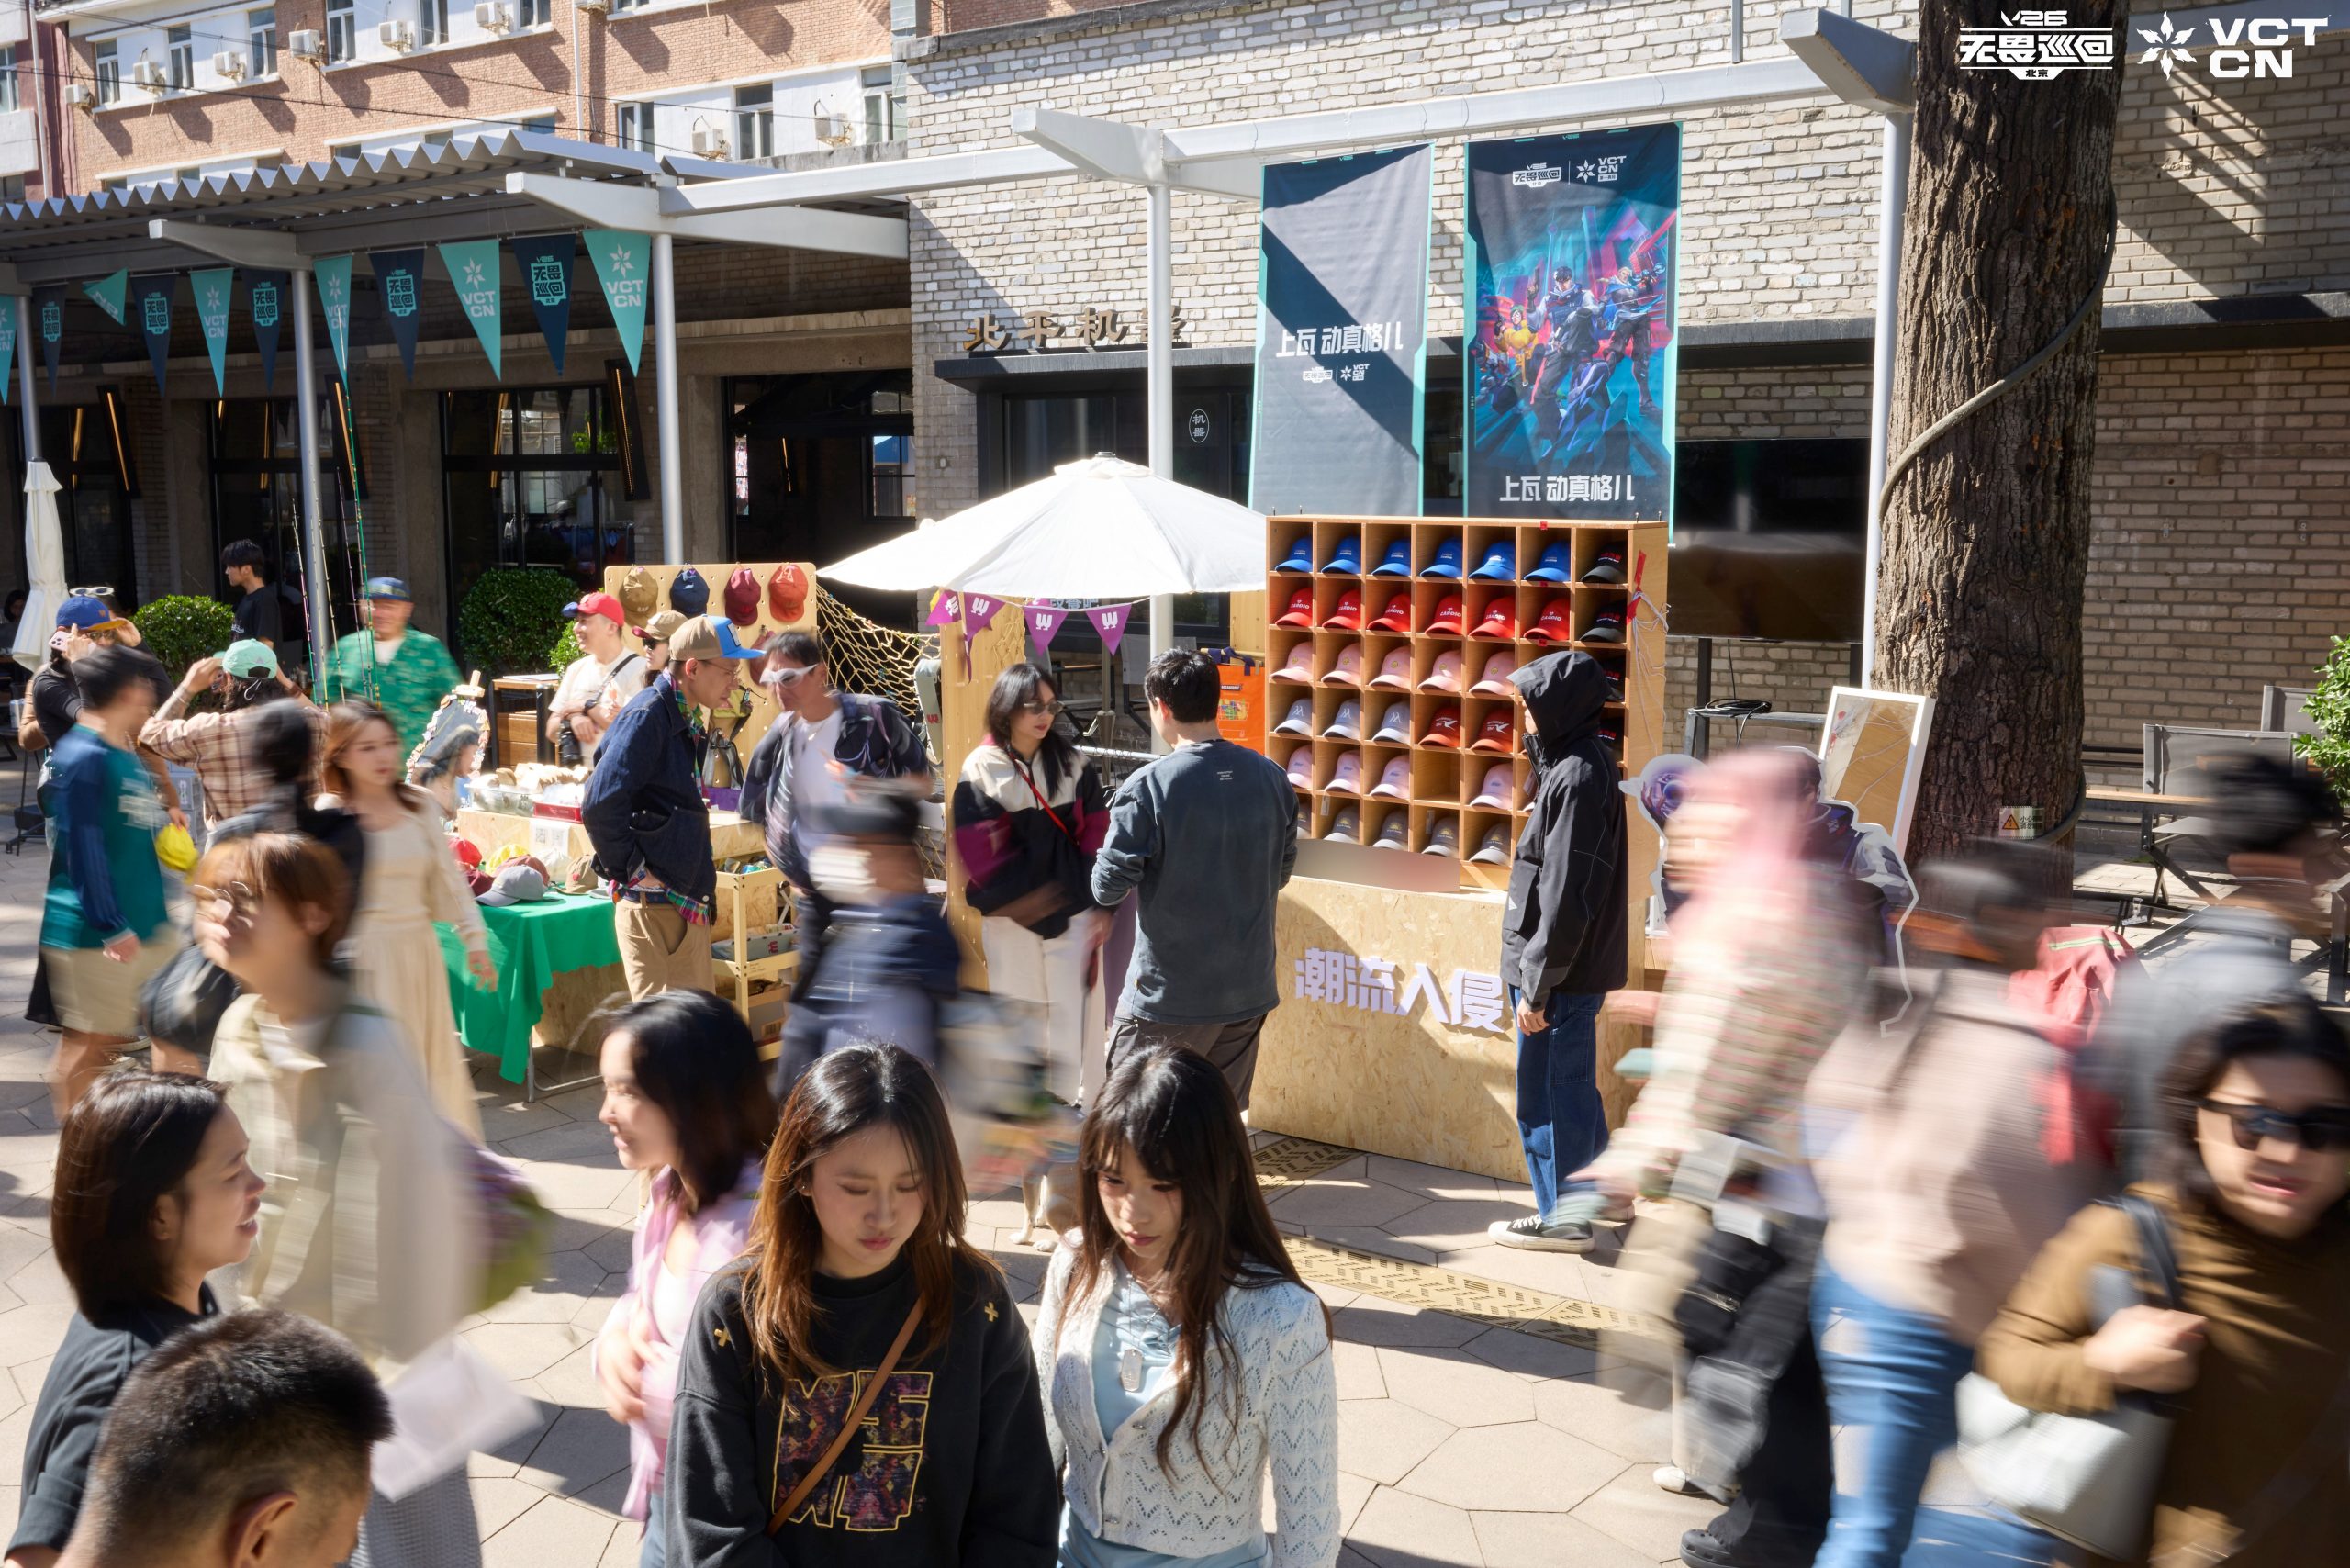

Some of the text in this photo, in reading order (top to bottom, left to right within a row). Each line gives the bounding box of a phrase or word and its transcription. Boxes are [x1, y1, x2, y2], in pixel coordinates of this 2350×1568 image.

[1598, 156, 1627, 165] VCT
[1598, 164, 1618, 174] CN
[606, 279, 643, 295] VCT
[462, 290, 496, 305] VCT
[614, 294, 642, 308] CN
[470, 305, 496, 318] CN
[204, 314, 227, 326] VCT
[208, 327, 225, 338] CN
[1275, 321, 1404, 357] 上瓦 动真格儿
[1192, 414, 1206, 437] 机器
[1499, 474, 1636, 502] 上瓦 动真格儿
[1294, 946, 1505, 1034] 潮流入侵
